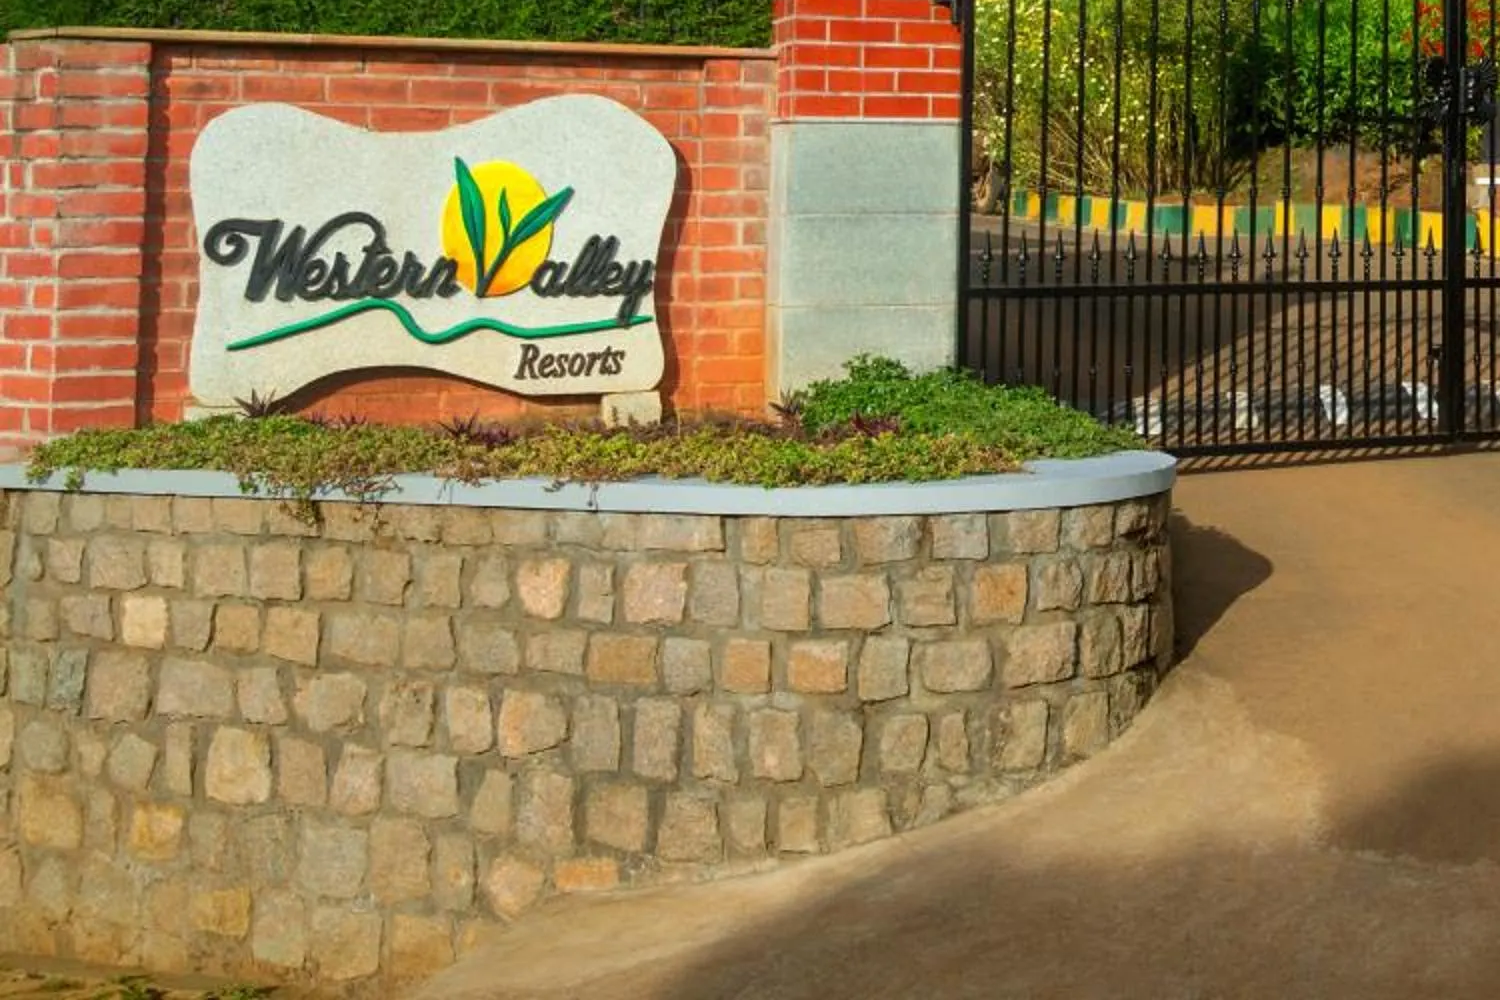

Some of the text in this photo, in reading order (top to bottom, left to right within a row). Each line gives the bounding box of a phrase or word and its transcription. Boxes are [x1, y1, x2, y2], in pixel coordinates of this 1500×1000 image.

[203, 155, 655, 326] Western Valley
[513, 343, 626, 381] Resorts
